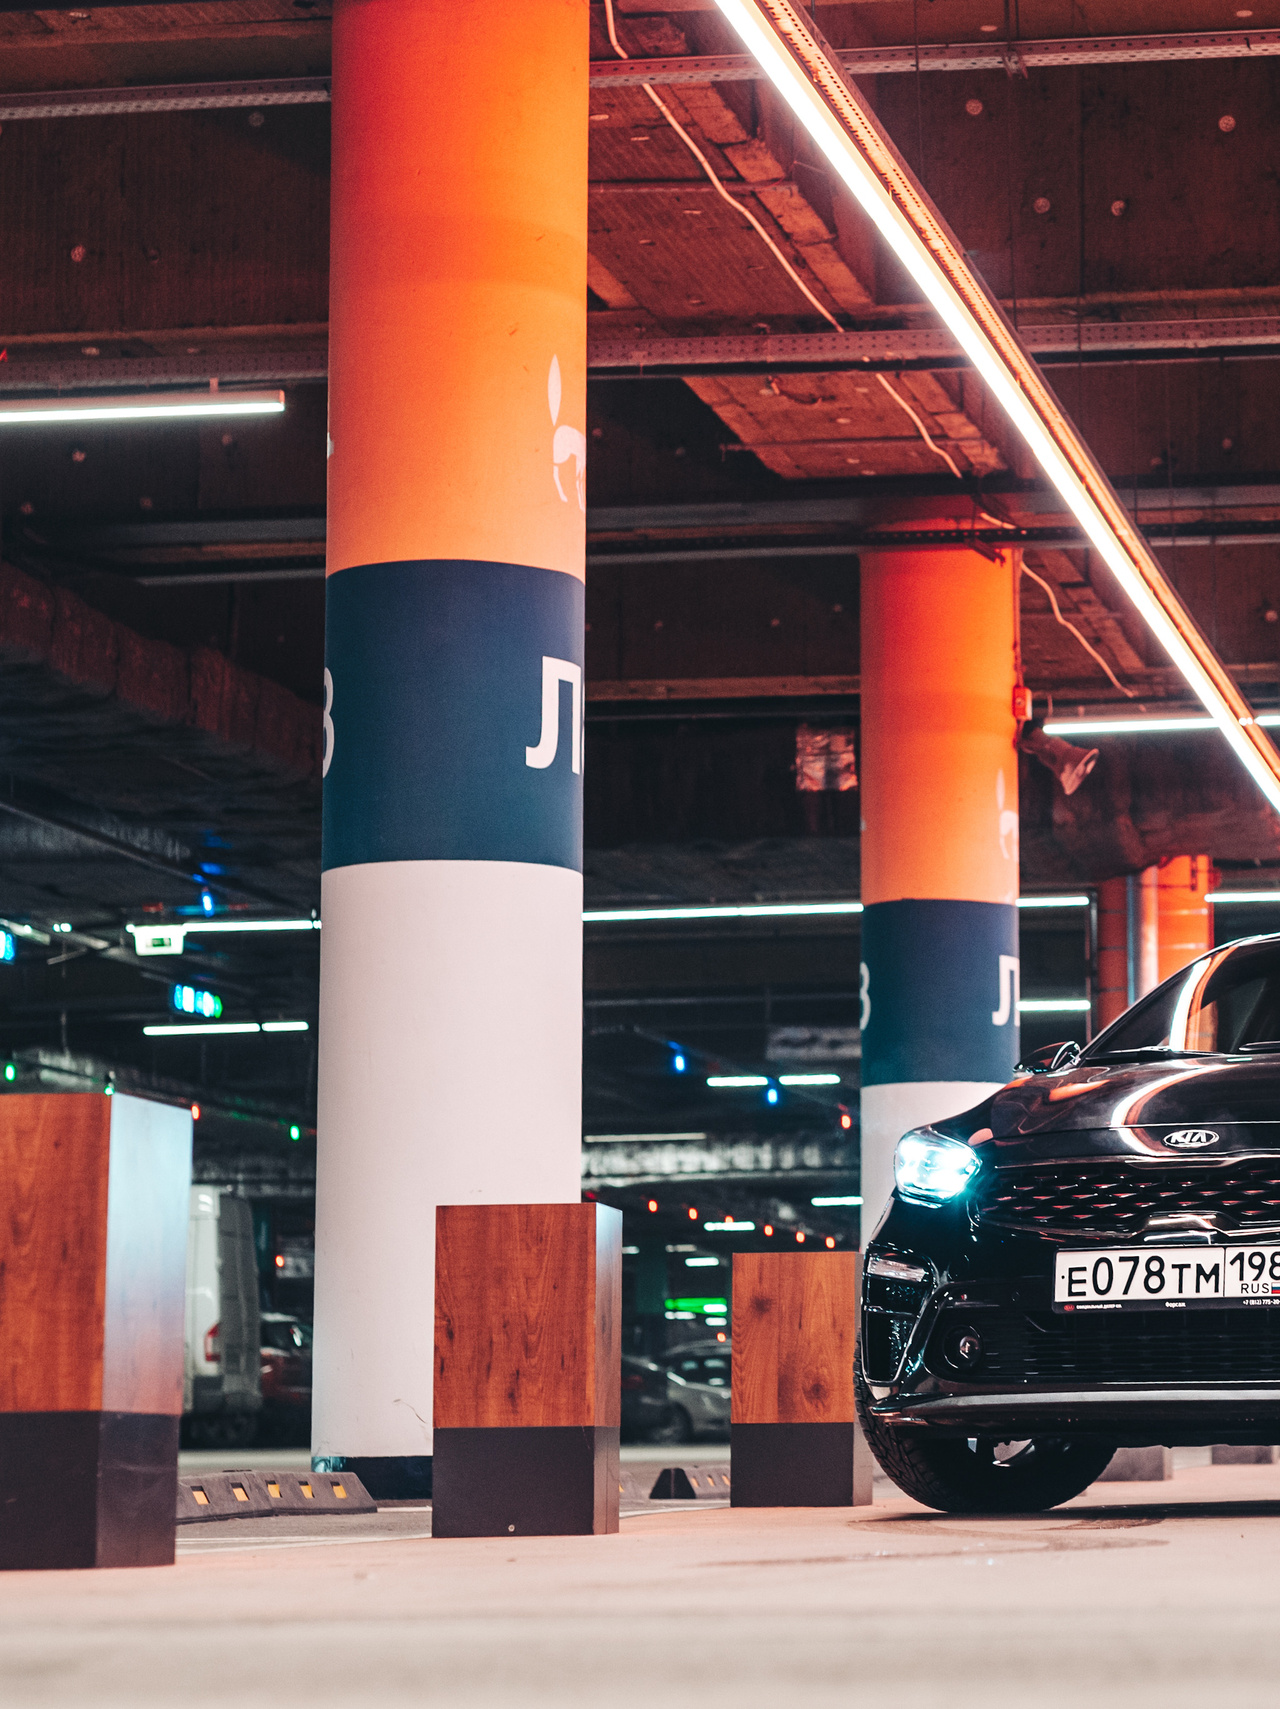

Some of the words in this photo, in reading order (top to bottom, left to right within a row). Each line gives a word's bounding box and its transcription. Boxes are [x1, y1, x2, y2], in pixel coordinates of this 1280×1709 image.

[526, 656, 585, 776] Л
[1166, 1130, 1212, 1146] KIA
[1067, 1255, 1220, 1297] Е078ТМ
[1240, 1283, 1270, 1294] RUS
